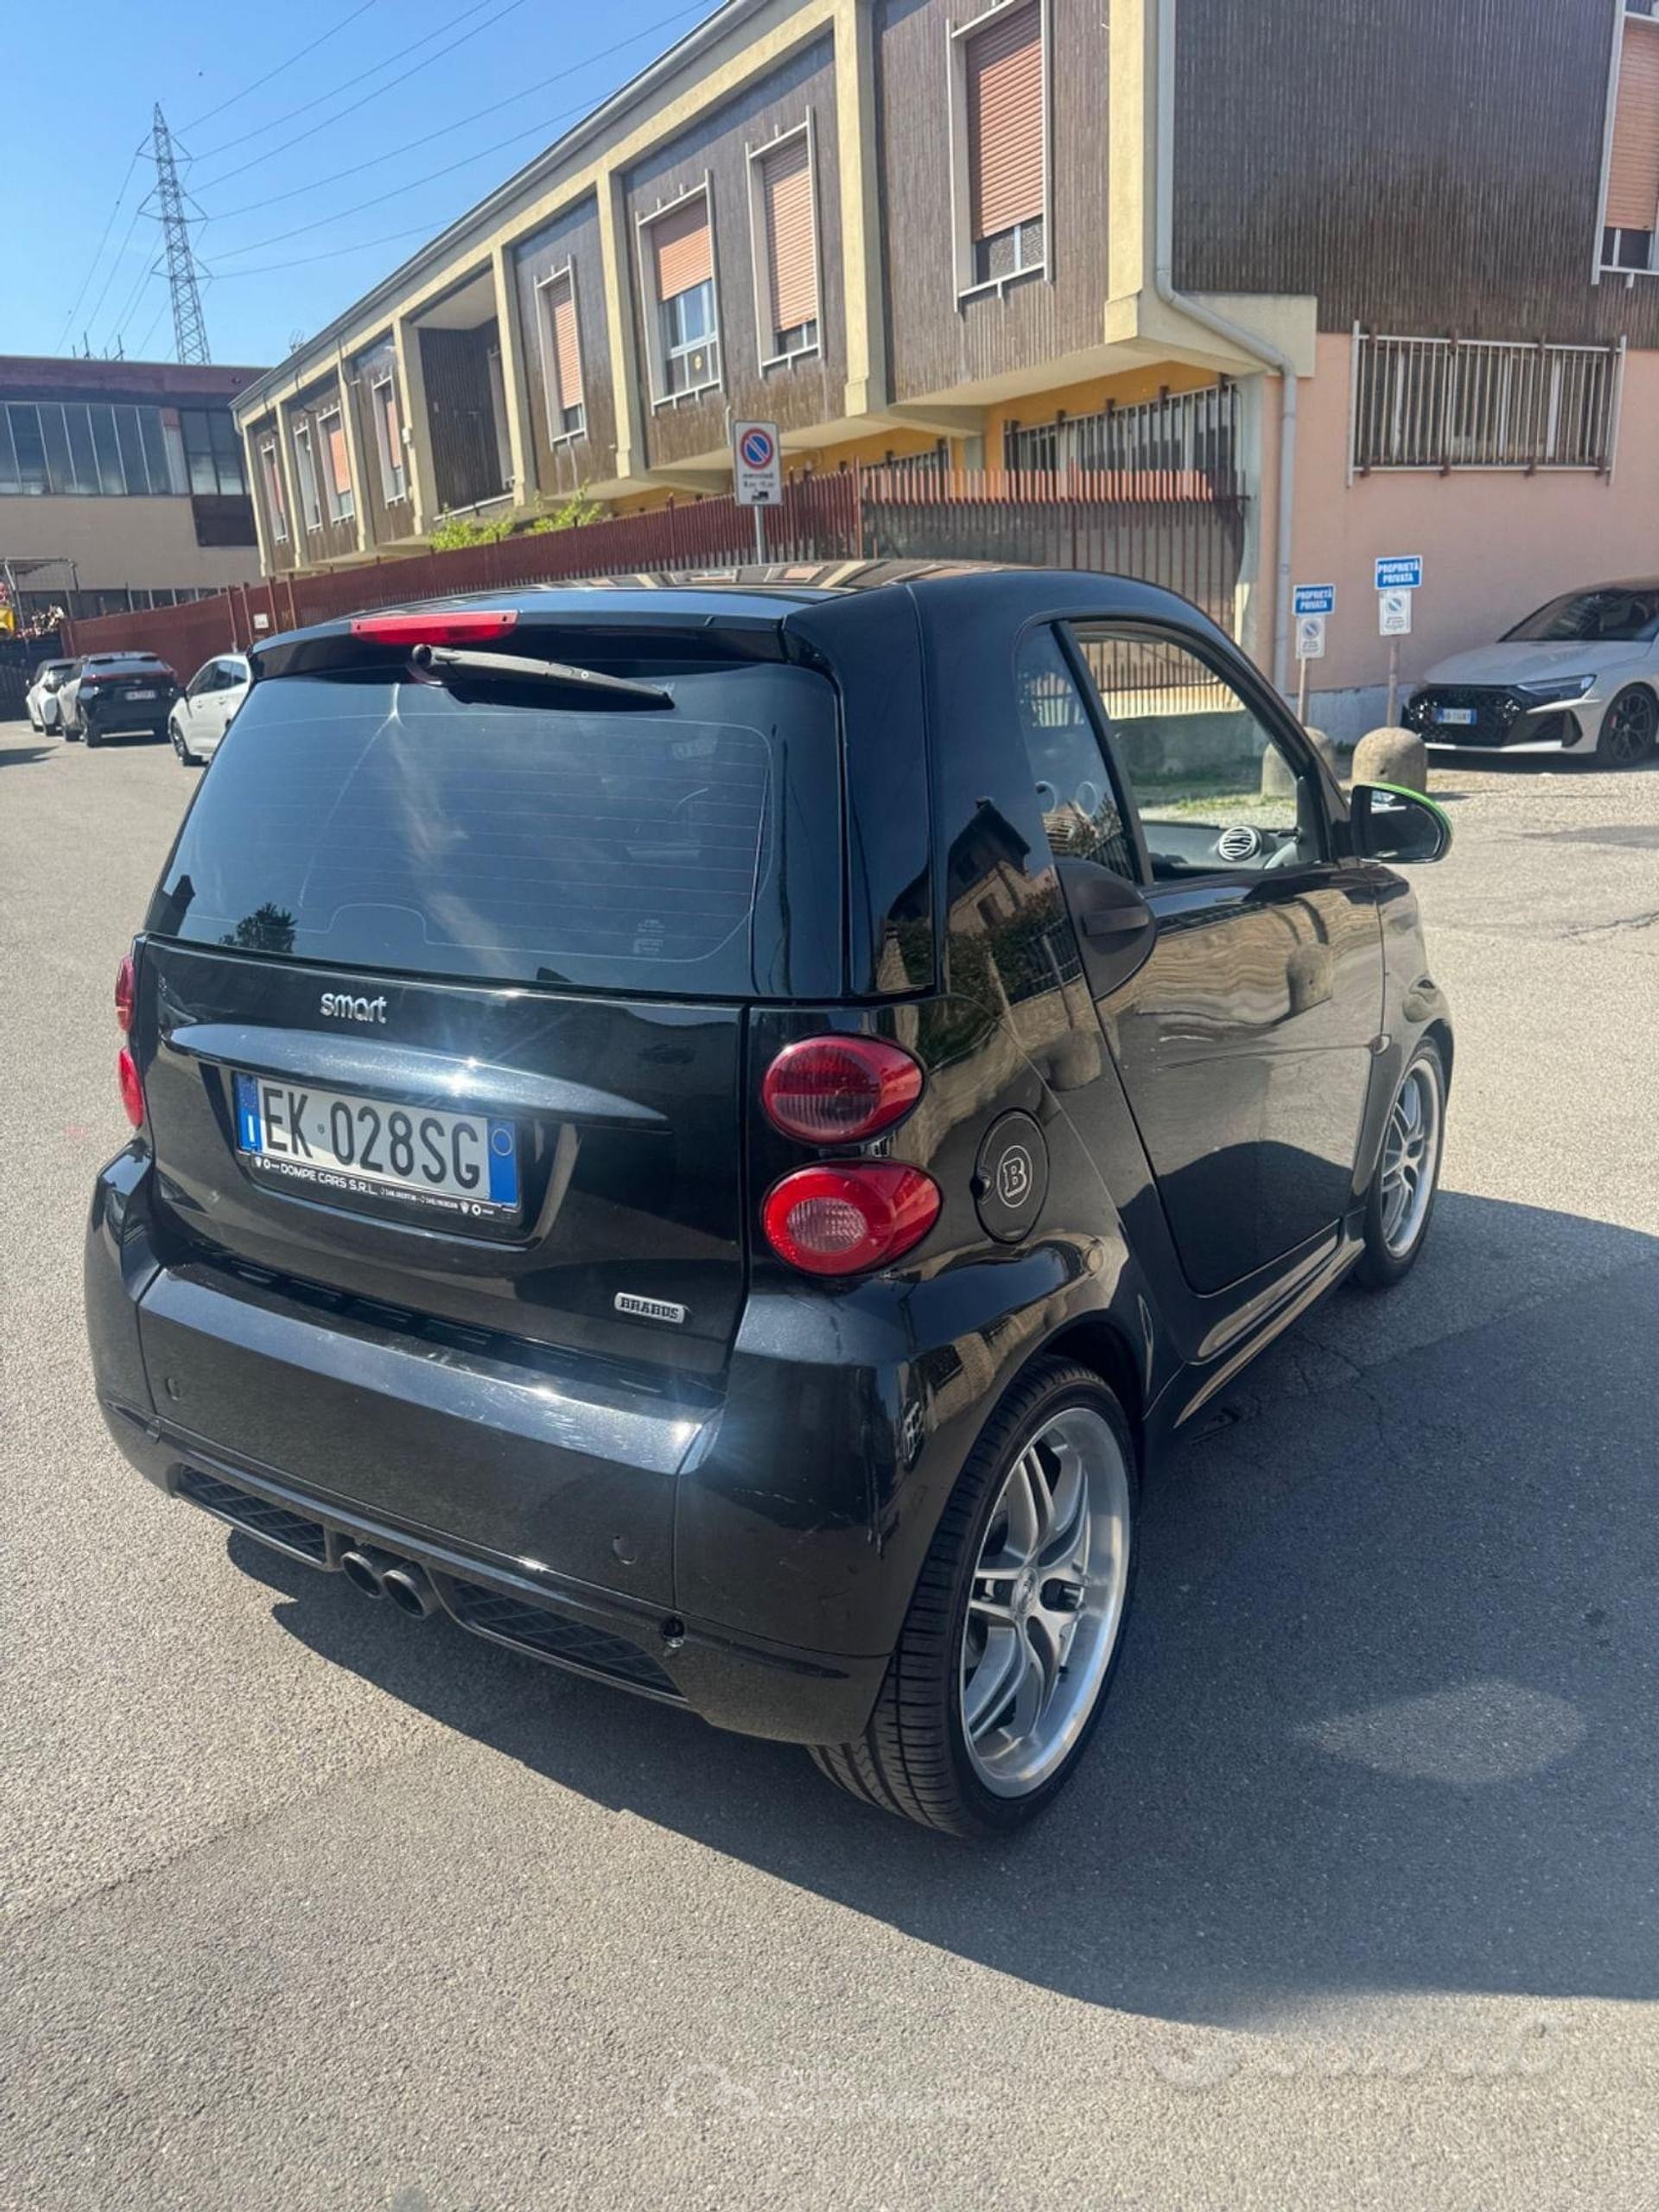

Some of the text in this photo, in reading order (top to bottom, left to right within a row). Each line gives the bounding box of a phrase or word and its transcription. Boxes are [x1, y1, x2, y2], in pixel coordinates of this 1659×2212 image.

[1382, 573, 1414, 584] PRIVATA
[1300, 600, 1328, 611] PRIVATA
[320, 993, 386, 1024] smart
[280, 1163, 317, 1182] DOMPE
[317, 1173, 346, 1189] CARS
[620, 1297, 679, 1319] BRABUS
